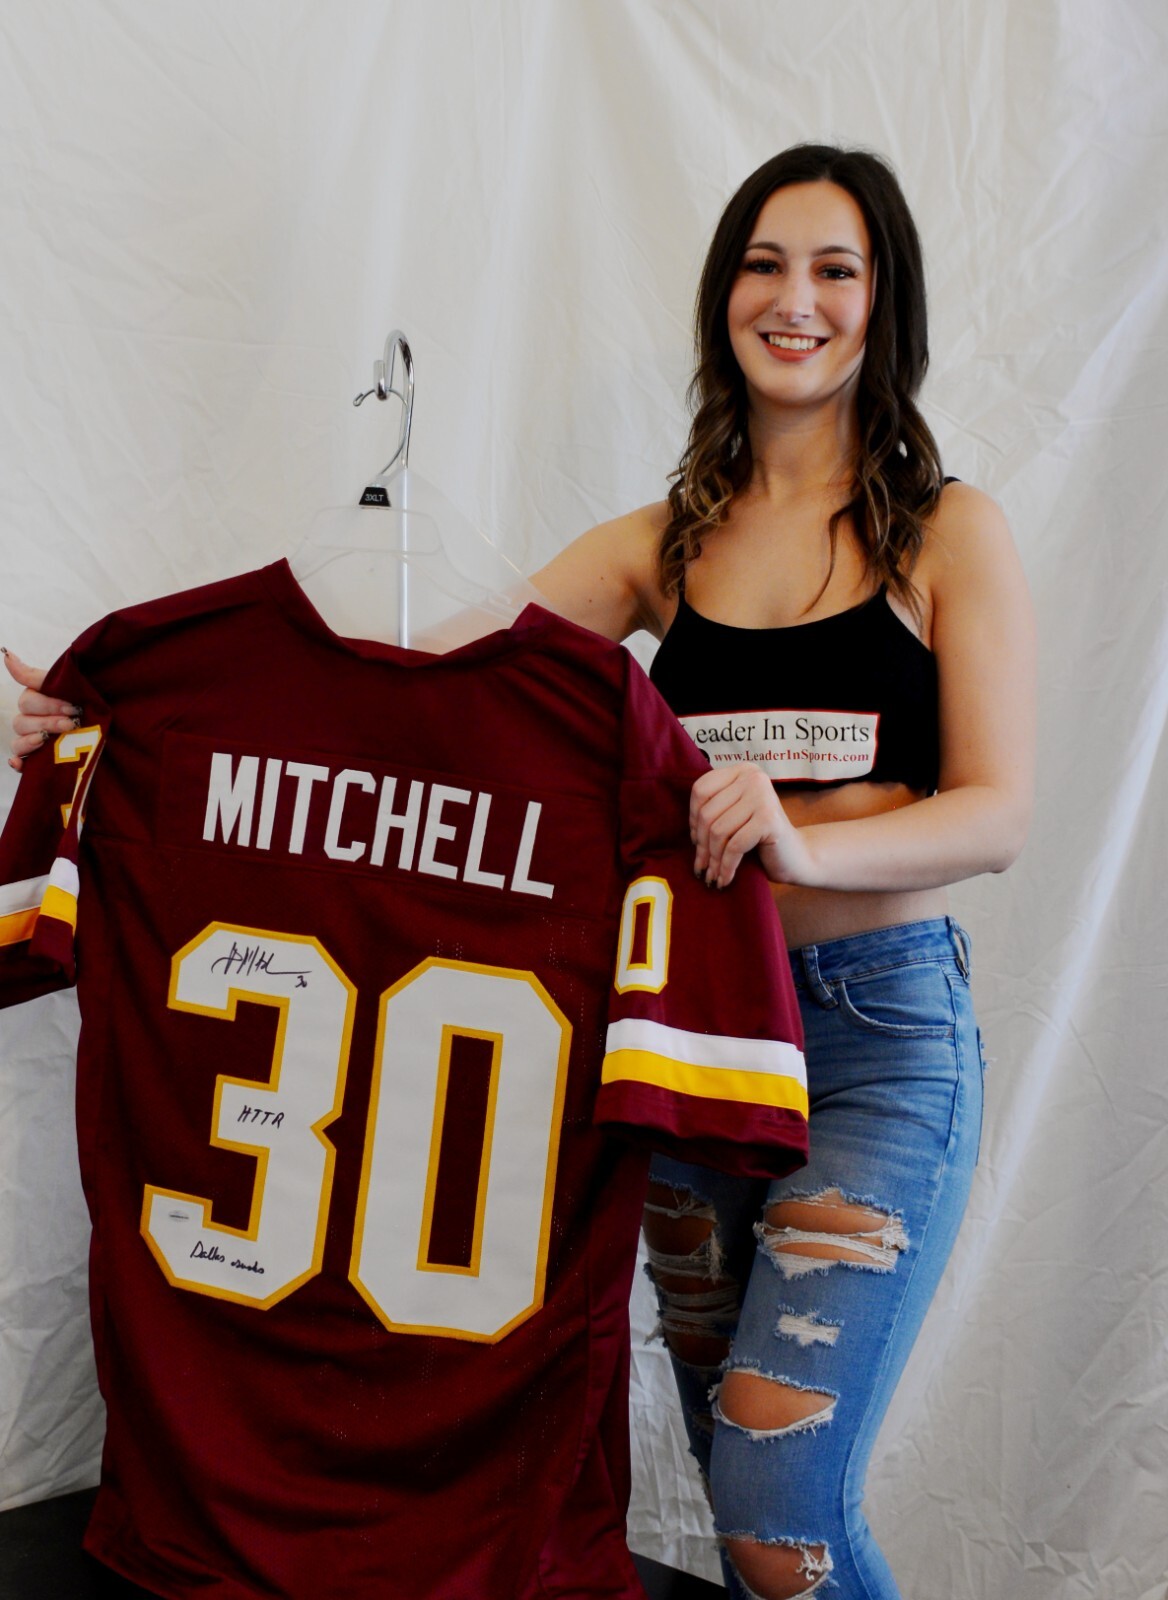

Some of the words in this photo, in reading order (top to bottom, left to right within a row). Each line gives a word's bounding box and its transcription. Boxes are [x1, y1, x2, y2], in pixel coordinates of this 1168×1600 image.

[364, 493, 384, 502] 3XLT
[682, 719, 756, 744] eader
[763, 718, 785, 741] In
[795, 717, 870, 746] Sports
[714, 749, 870, 763] www.LeaderInSports.com
[202, 752, 555, 899] MITCHELL
[614, 875, 674, 995] 0
[237, 1104, 285, 1129] HTTR
[139, 921, 573, 1345] 30
[190, 1240, 225, 1262] Dallas
